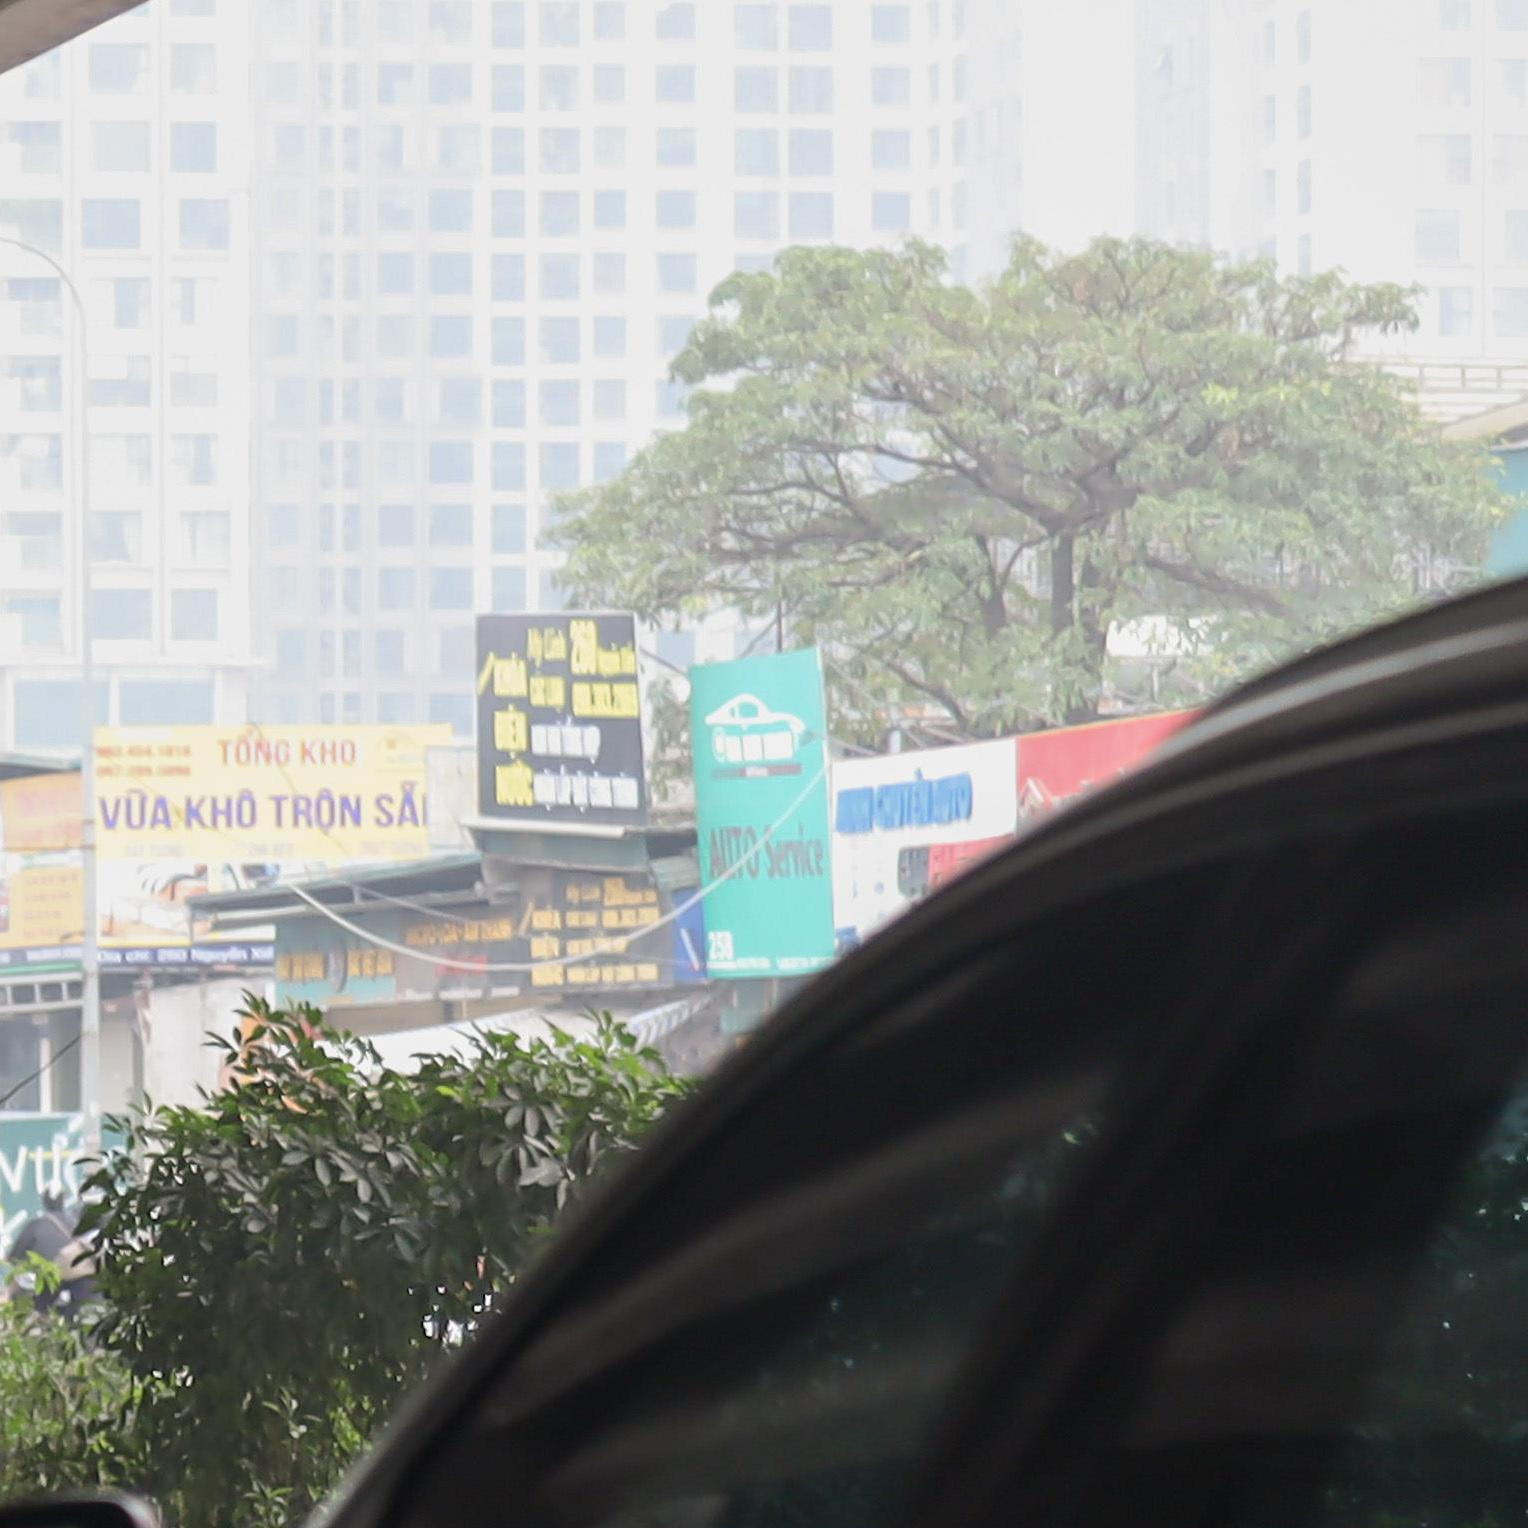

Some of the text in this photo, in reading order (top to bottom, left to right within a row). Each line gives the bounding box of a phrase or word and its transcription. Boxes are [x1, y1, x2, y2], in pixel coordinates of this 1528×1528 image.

[217, 725, 356, 767] TỔNG KHO
[98, 788, 173, 830] VỮA
[182, 787, 257, 828] KHÔ
[269, 787, 363, 835] TRỘN
[373, 779, 427, 829] SẴ
[709, 822, 823, 882] AUTO Service
